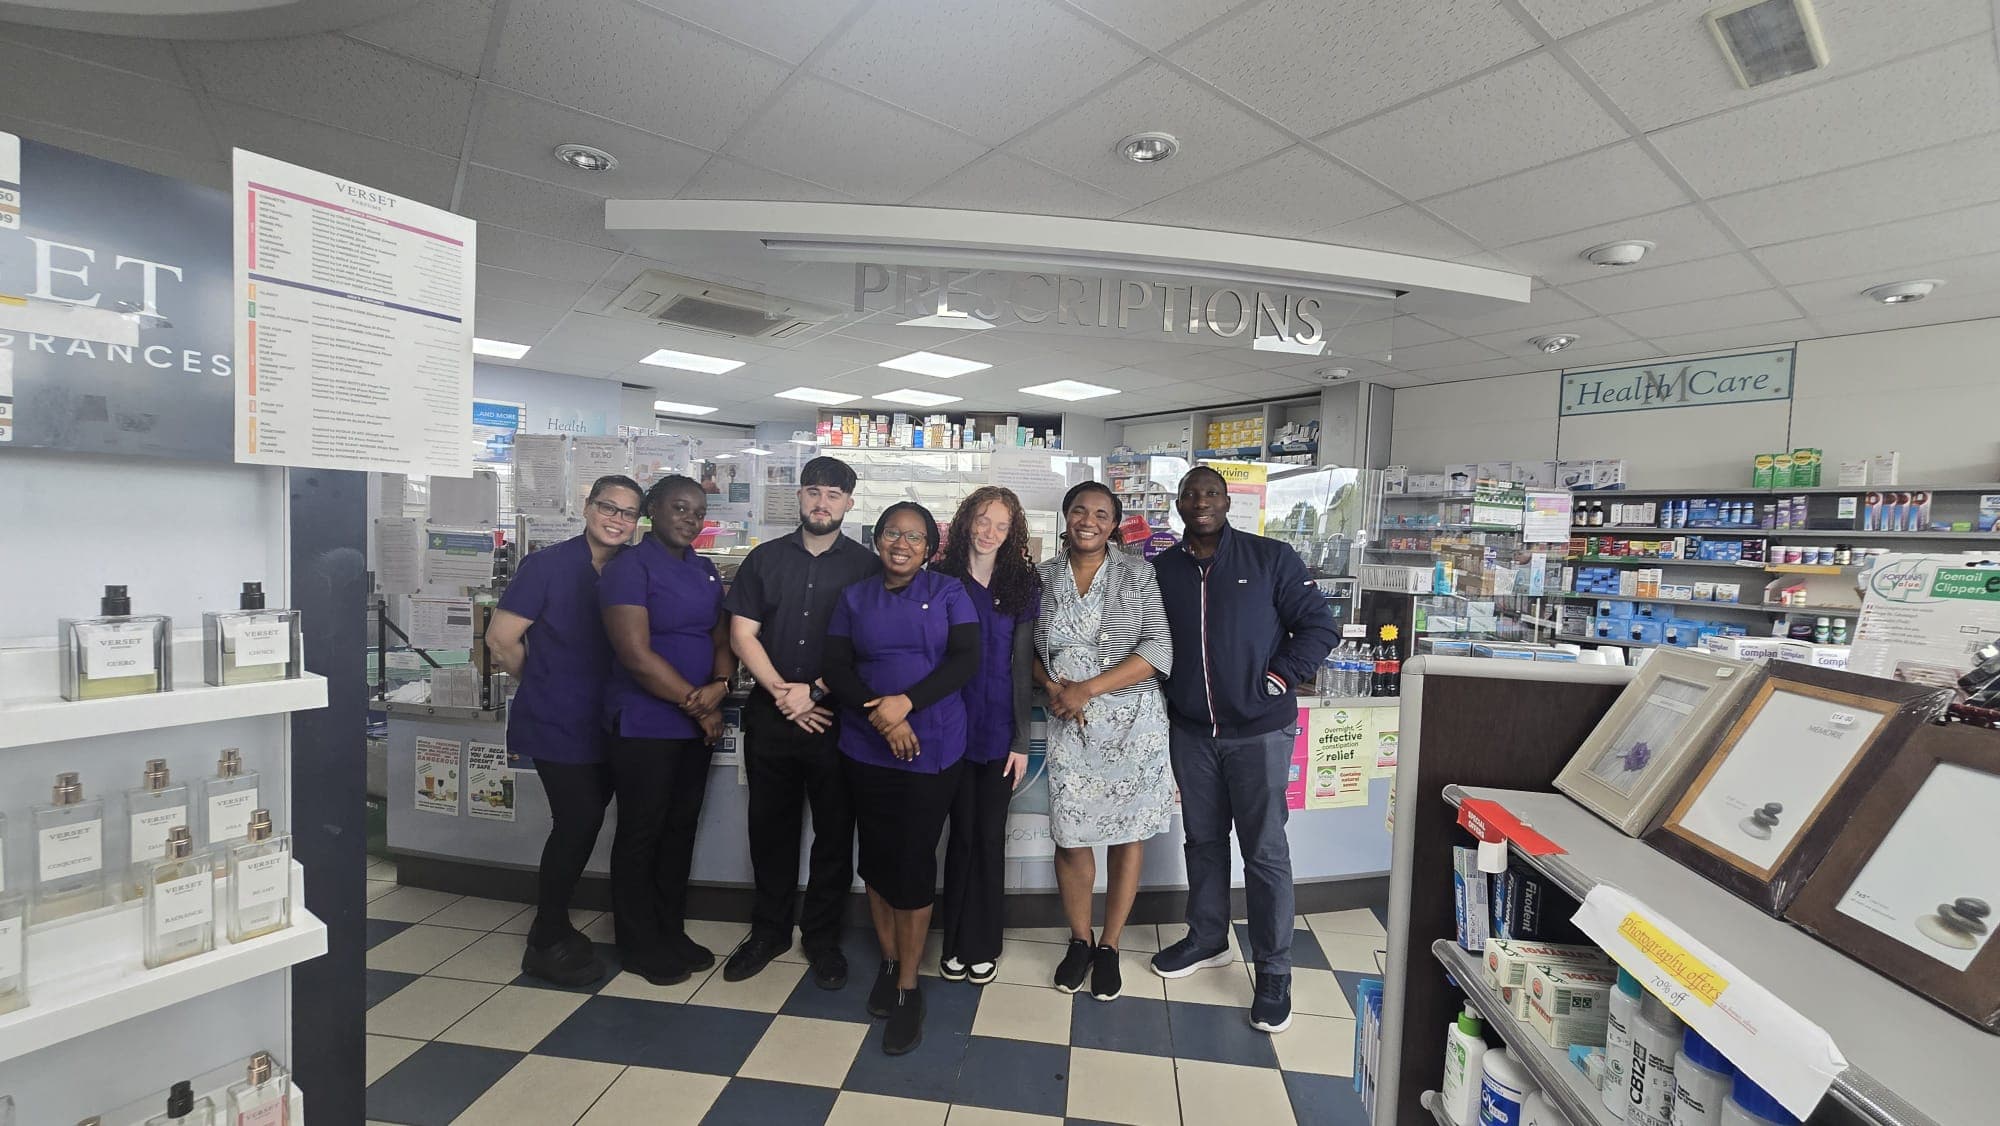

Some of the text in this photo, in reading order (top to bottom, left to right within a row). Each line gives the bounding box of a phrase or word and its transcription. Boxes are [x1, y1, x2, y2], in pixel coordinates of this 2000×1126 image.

[336, 182, 396, 208] VERSET
[853, 262, 1322, 345] PRESCRIPTIONS
[1577, 370, 1769, 406] Health Care
[547, 418, 587, 433] Health
[1939, 571, 1983, 582] Toenail
[1935, 582, 1987, 595] Clippers
[99, 638, 142, 647] VERSET
[1740, 648, 1778, 659] Complan
[1318, 732, 1362, 744] effective
[1324, 726, 1354, 735] Overnight
[1322, 742, 1358, 751] constipation
[1326, 750, 1354, 762] relief
[1467, 810, 1486, 831] SPECIAL
[1467, 820, 1485, 840] OFFERS
[1522, 880, 1537, 932] Fixodent
[1620, 917, 1723, 1001] Photography offers
[1650, 975, 1689, 1007] 70% off
[1629, 1058, 1646, 1105] CB12
